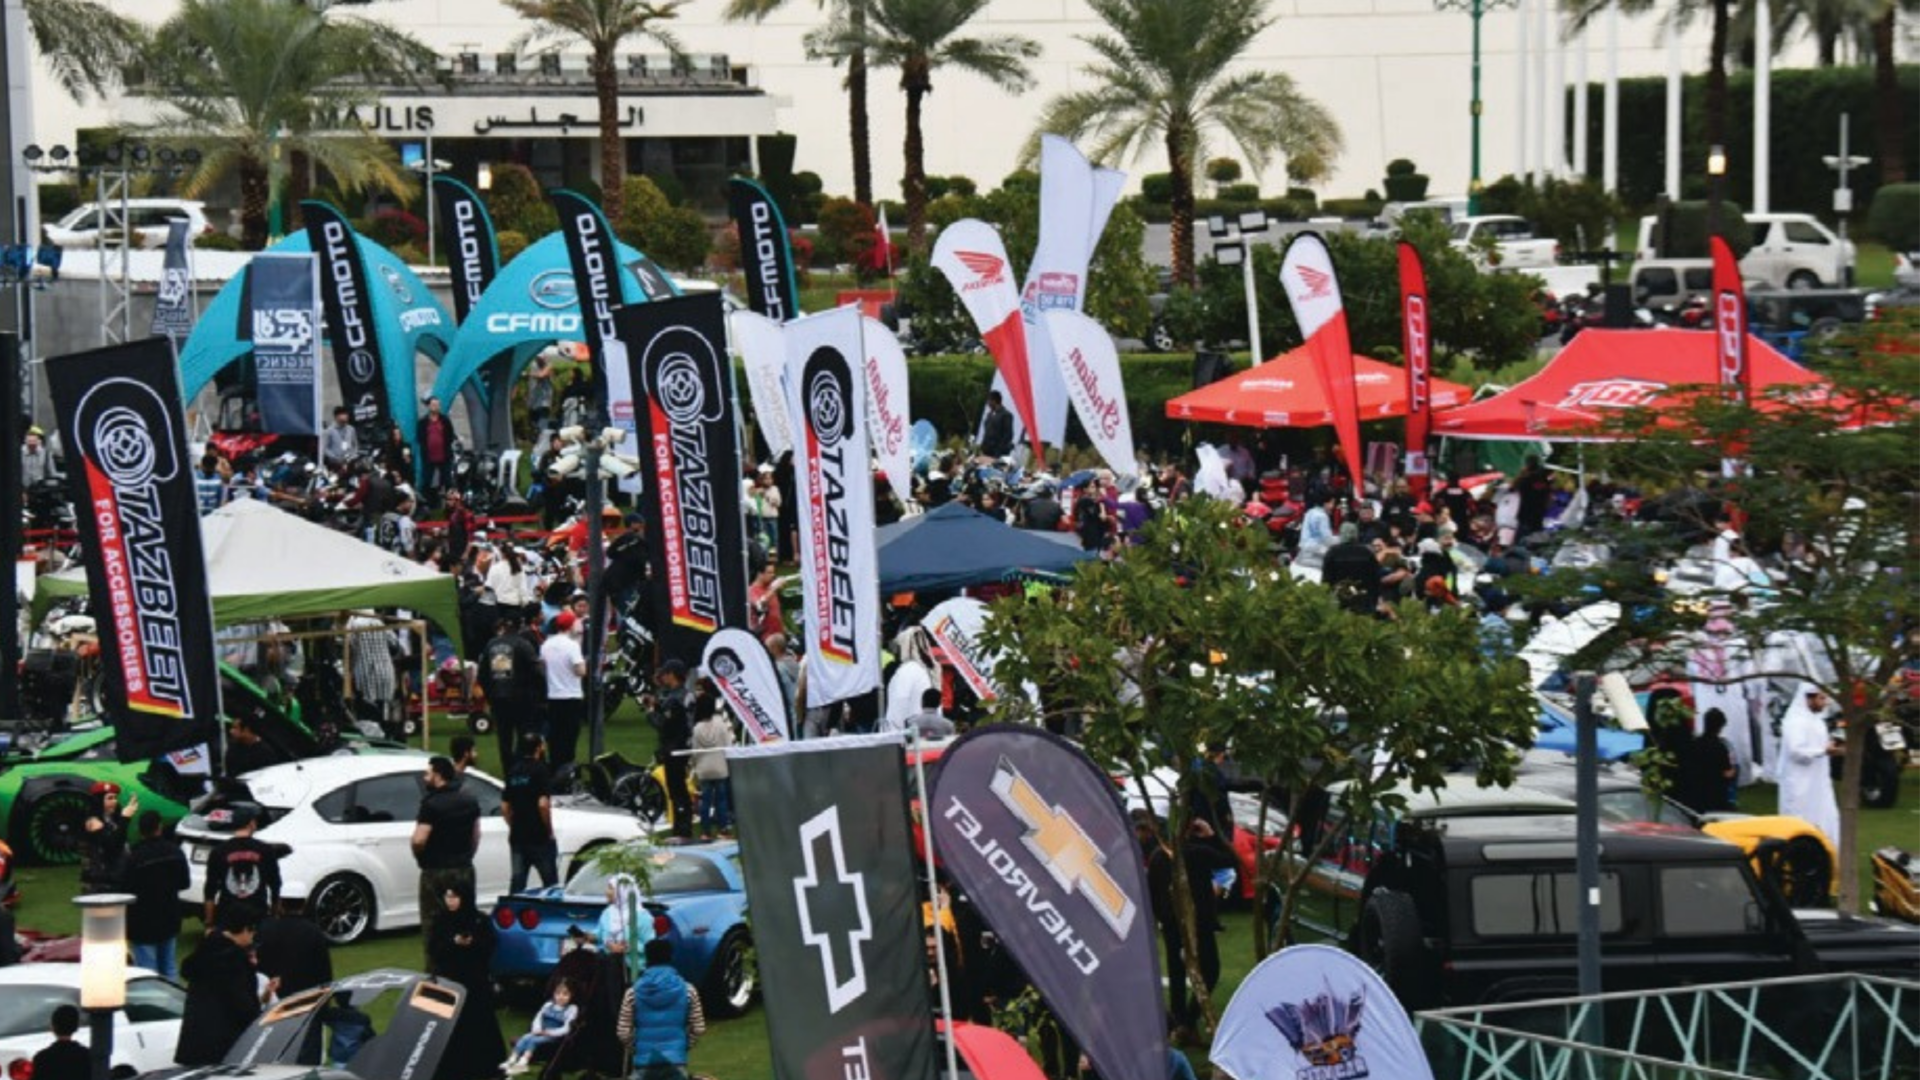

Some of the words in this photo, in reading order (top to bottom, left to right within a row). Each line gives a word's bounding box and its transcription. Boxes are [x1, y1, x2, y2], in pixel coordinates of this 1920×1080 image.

[474, 106, 644, 134] الجلس
[323, 220, 366, 348] CFMOTO
[455, 200, 482, 311] FMOTO
[576, 212, 616, 340] CFMOTO
[752, 201, 785, 324] CFMOTO
[487, 313, 581, 333] CFMO
[654, 432, 670, 472] FOR
[809, 456, 821, 497] FOR
[95, 498, 118, 543] FOR
[659, 477, 685, 609] ACCESSORIES
[671, 422, 724, 627] TAZBEET
[813, 504, 831, 641] ACCESSORIES
[820, 447, 858, 664] TAZBEET
[104, 547, 143, 694] ACCESSORIES
[114, 484, 194, 719] TAZBEET
